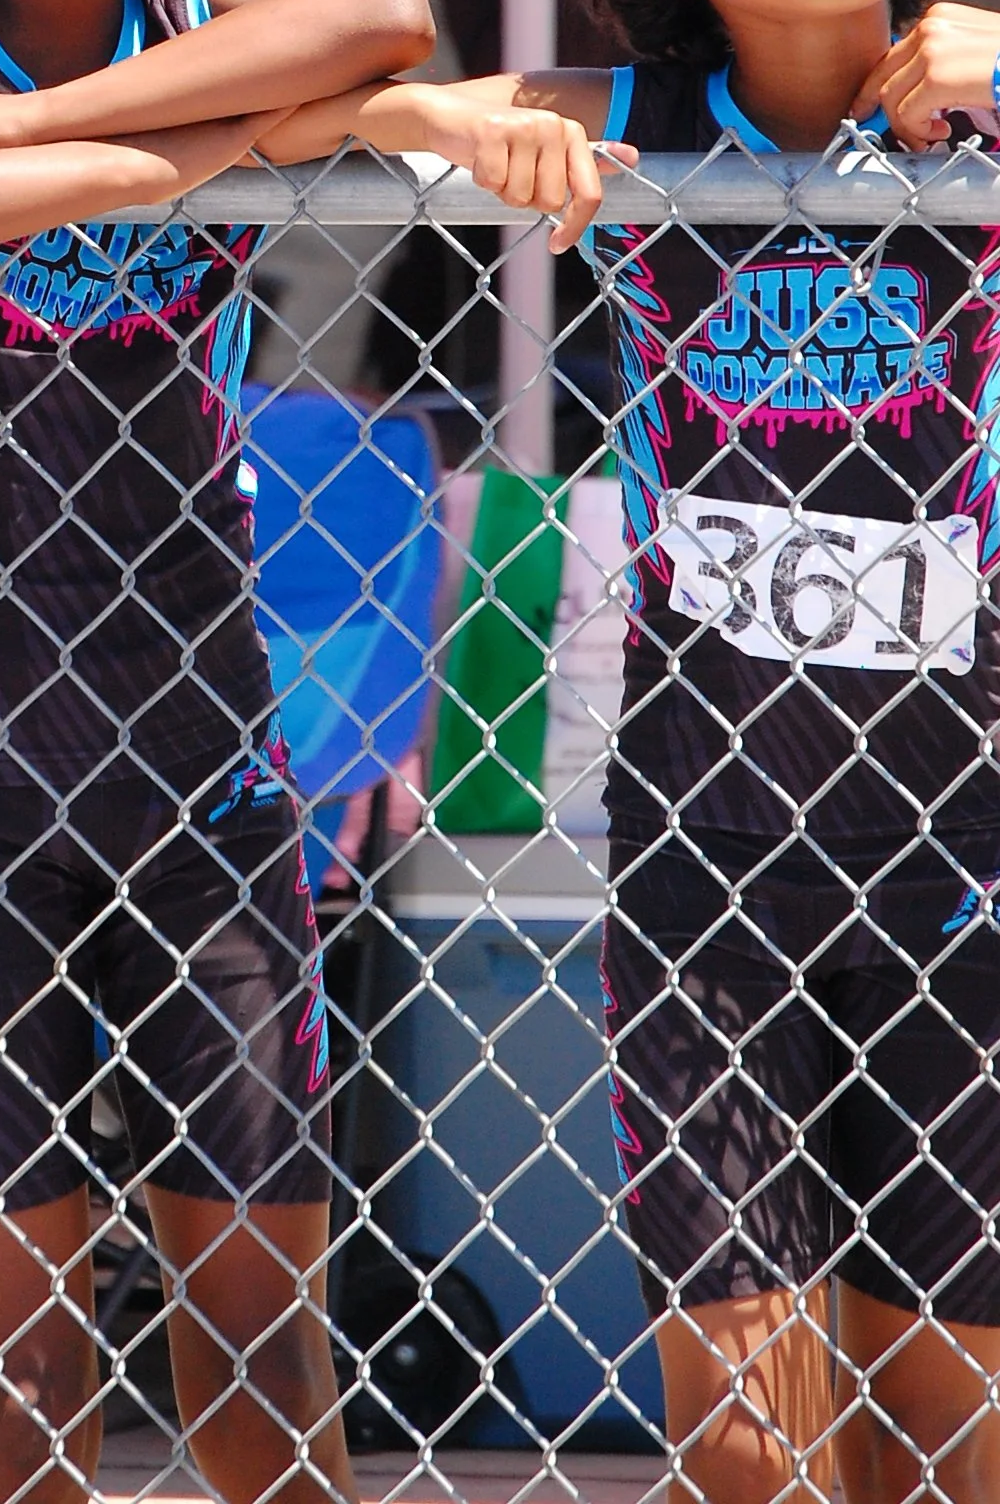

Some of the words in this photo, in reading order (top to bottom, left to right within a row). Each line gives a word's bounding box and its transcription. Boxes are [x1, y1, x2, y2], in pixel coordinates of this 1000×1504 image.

[708, 267, 922, 351] JUSS
[686, 341, 949, 411] DOMINATE
[695, 513, 941, 656] 361
